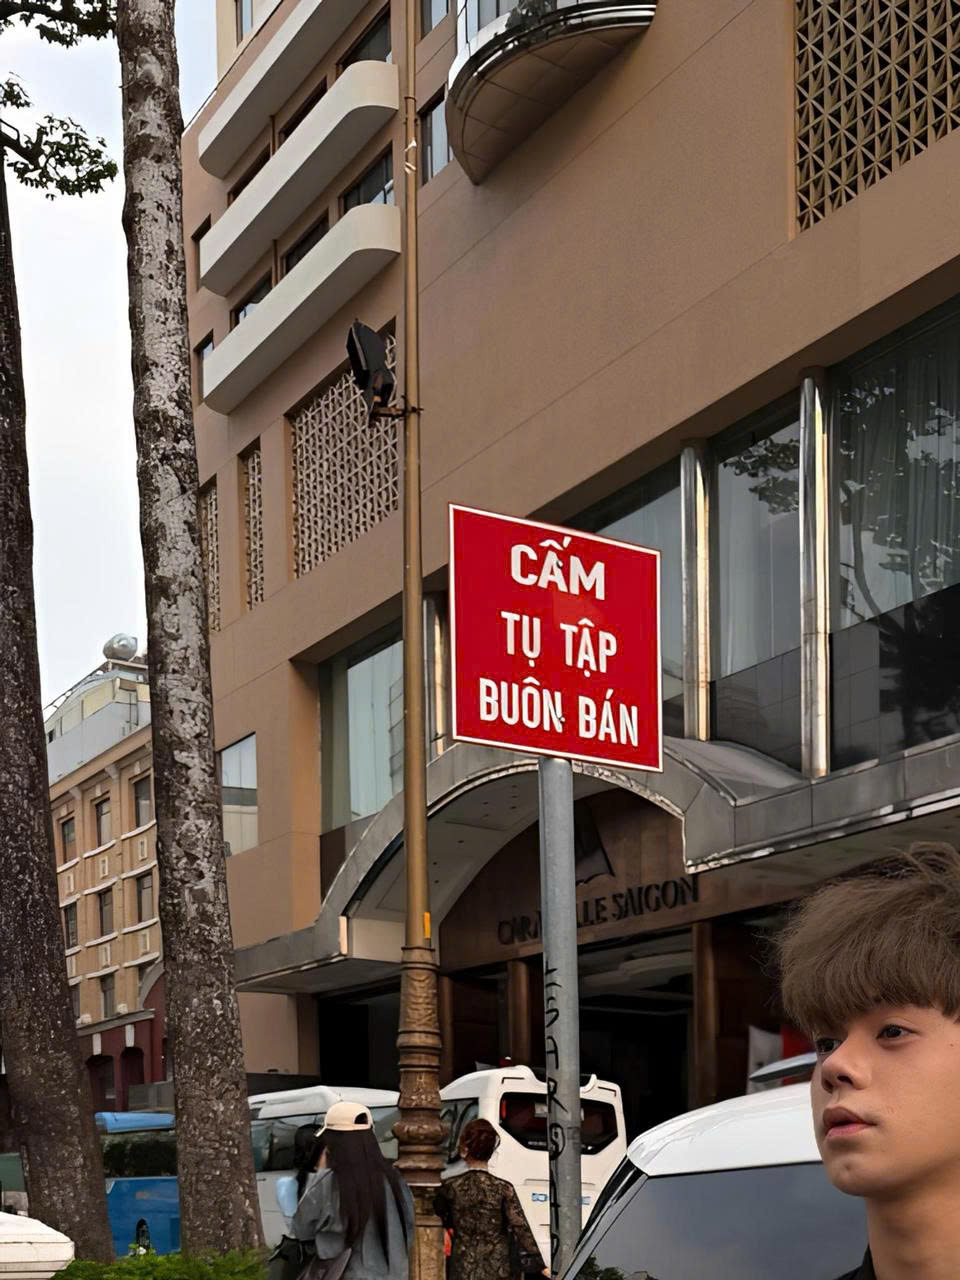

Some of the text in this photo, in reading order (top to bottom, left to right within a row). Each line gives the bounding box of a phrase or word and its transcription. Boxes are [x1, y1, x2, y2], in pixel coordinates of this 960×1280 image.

[511, 536, 605, 600] CẤM
[500, 611, 618, 678] TỤ TẬP
[479, 676, 639, 747] BUÔN BÁN
[611, 874, 699, 920] SAIGON
